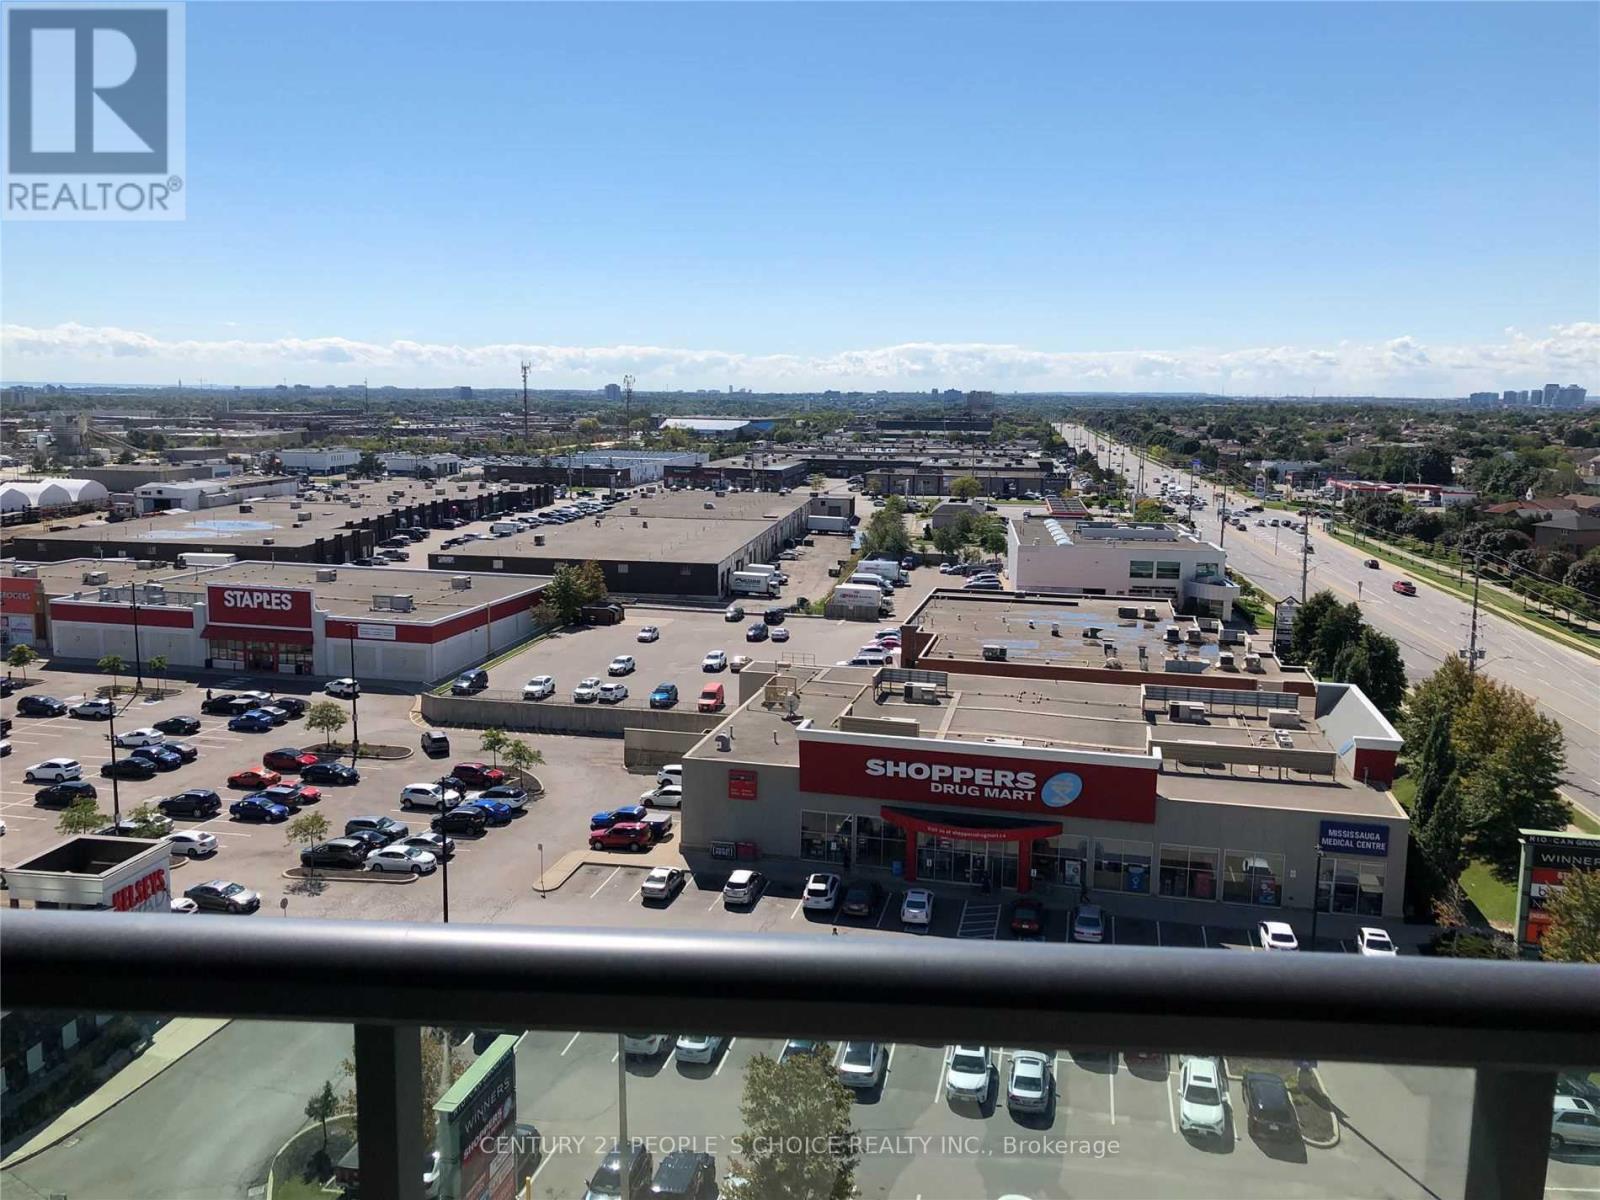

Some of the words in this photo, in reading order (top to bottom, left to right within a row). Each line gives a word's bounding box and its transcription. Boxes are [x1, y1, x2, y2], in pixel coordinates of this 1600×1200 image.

[223, 590, 292, 611] STAPLES
[865, 758, 1037, 790] SHOPPERS
[930, 782, 980, 797] DRUG
[984, 786, 1036, 801] MART
[1321, 837, 1354, 848] MEDICAL
[1356, 840, 1387, 851] CENTRE
[1328, 829, 1381, 841] MISSISSAUGA
[465, 1079, 511, 1134] WINNERS
